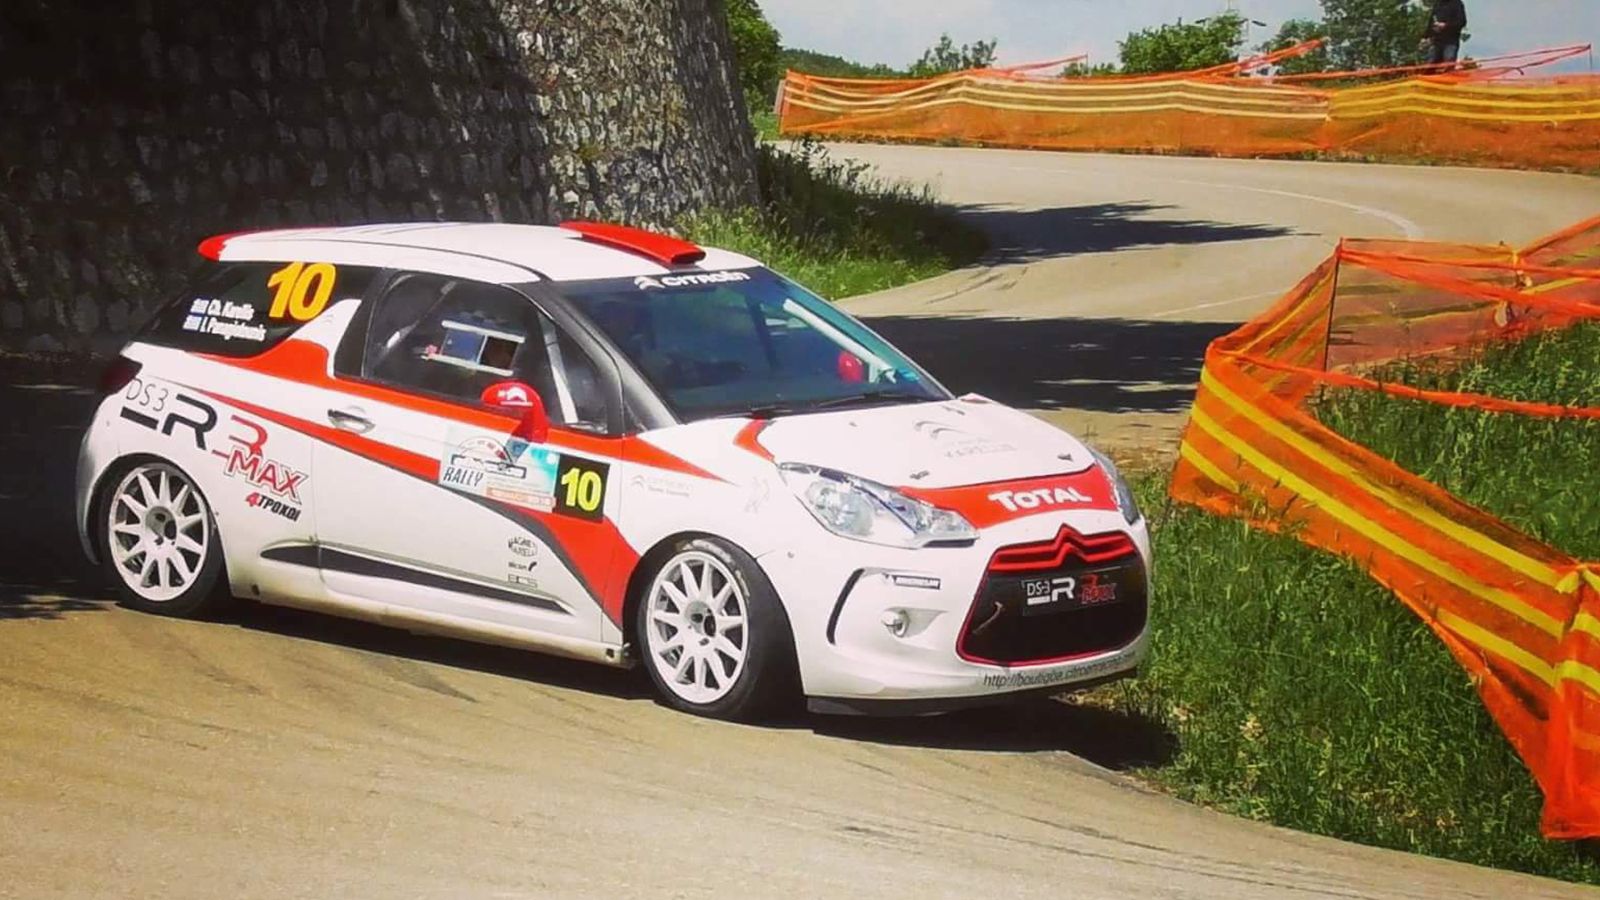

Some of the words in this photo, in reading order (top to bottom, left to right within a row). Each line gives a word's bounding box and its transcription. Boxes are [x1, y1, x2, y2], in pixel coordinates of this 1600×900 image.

[267, 261, 336, 321] 10
[561, 467, 602, 512] 10
[988, 487, 1092, 512] TOTAL
